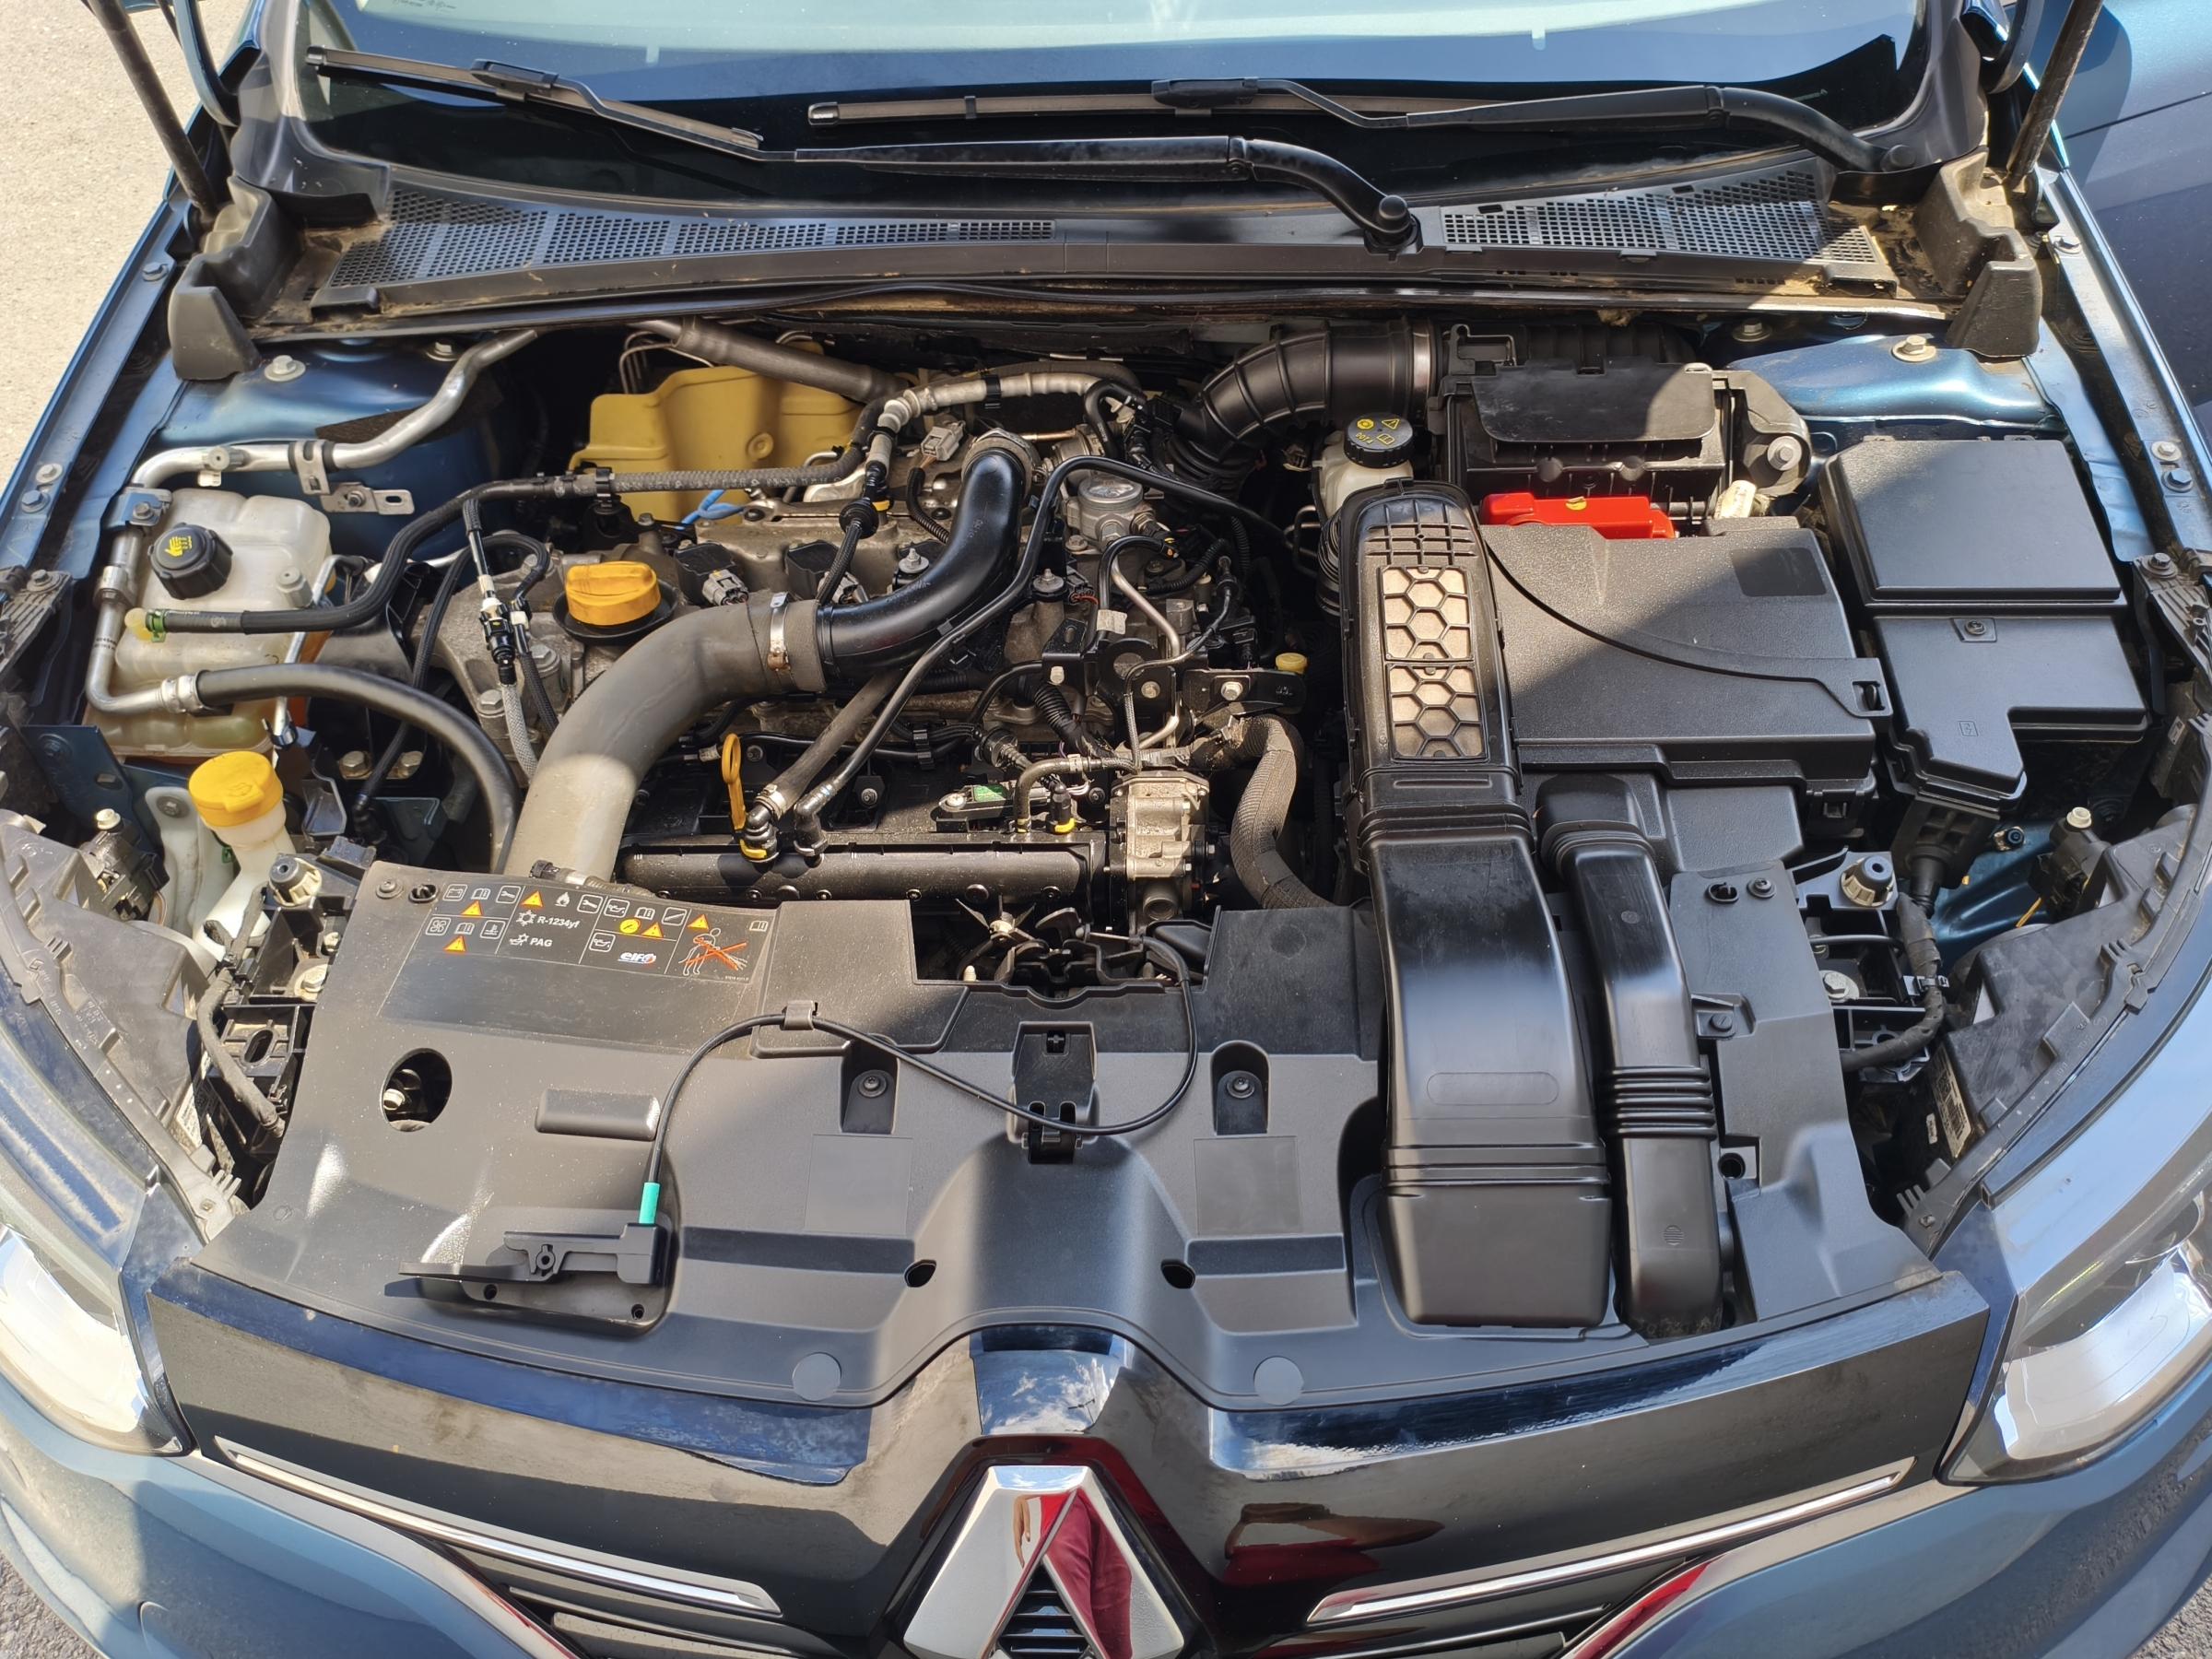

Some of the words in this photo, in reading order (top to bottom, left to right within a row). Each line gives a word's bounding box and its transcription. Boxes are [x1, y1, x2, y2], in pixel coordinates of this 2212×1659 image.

[537, 915, 580, 928] R-1234yf
[530, 937, 553, 947] PAG
[619, 952, 648, 962] elf
